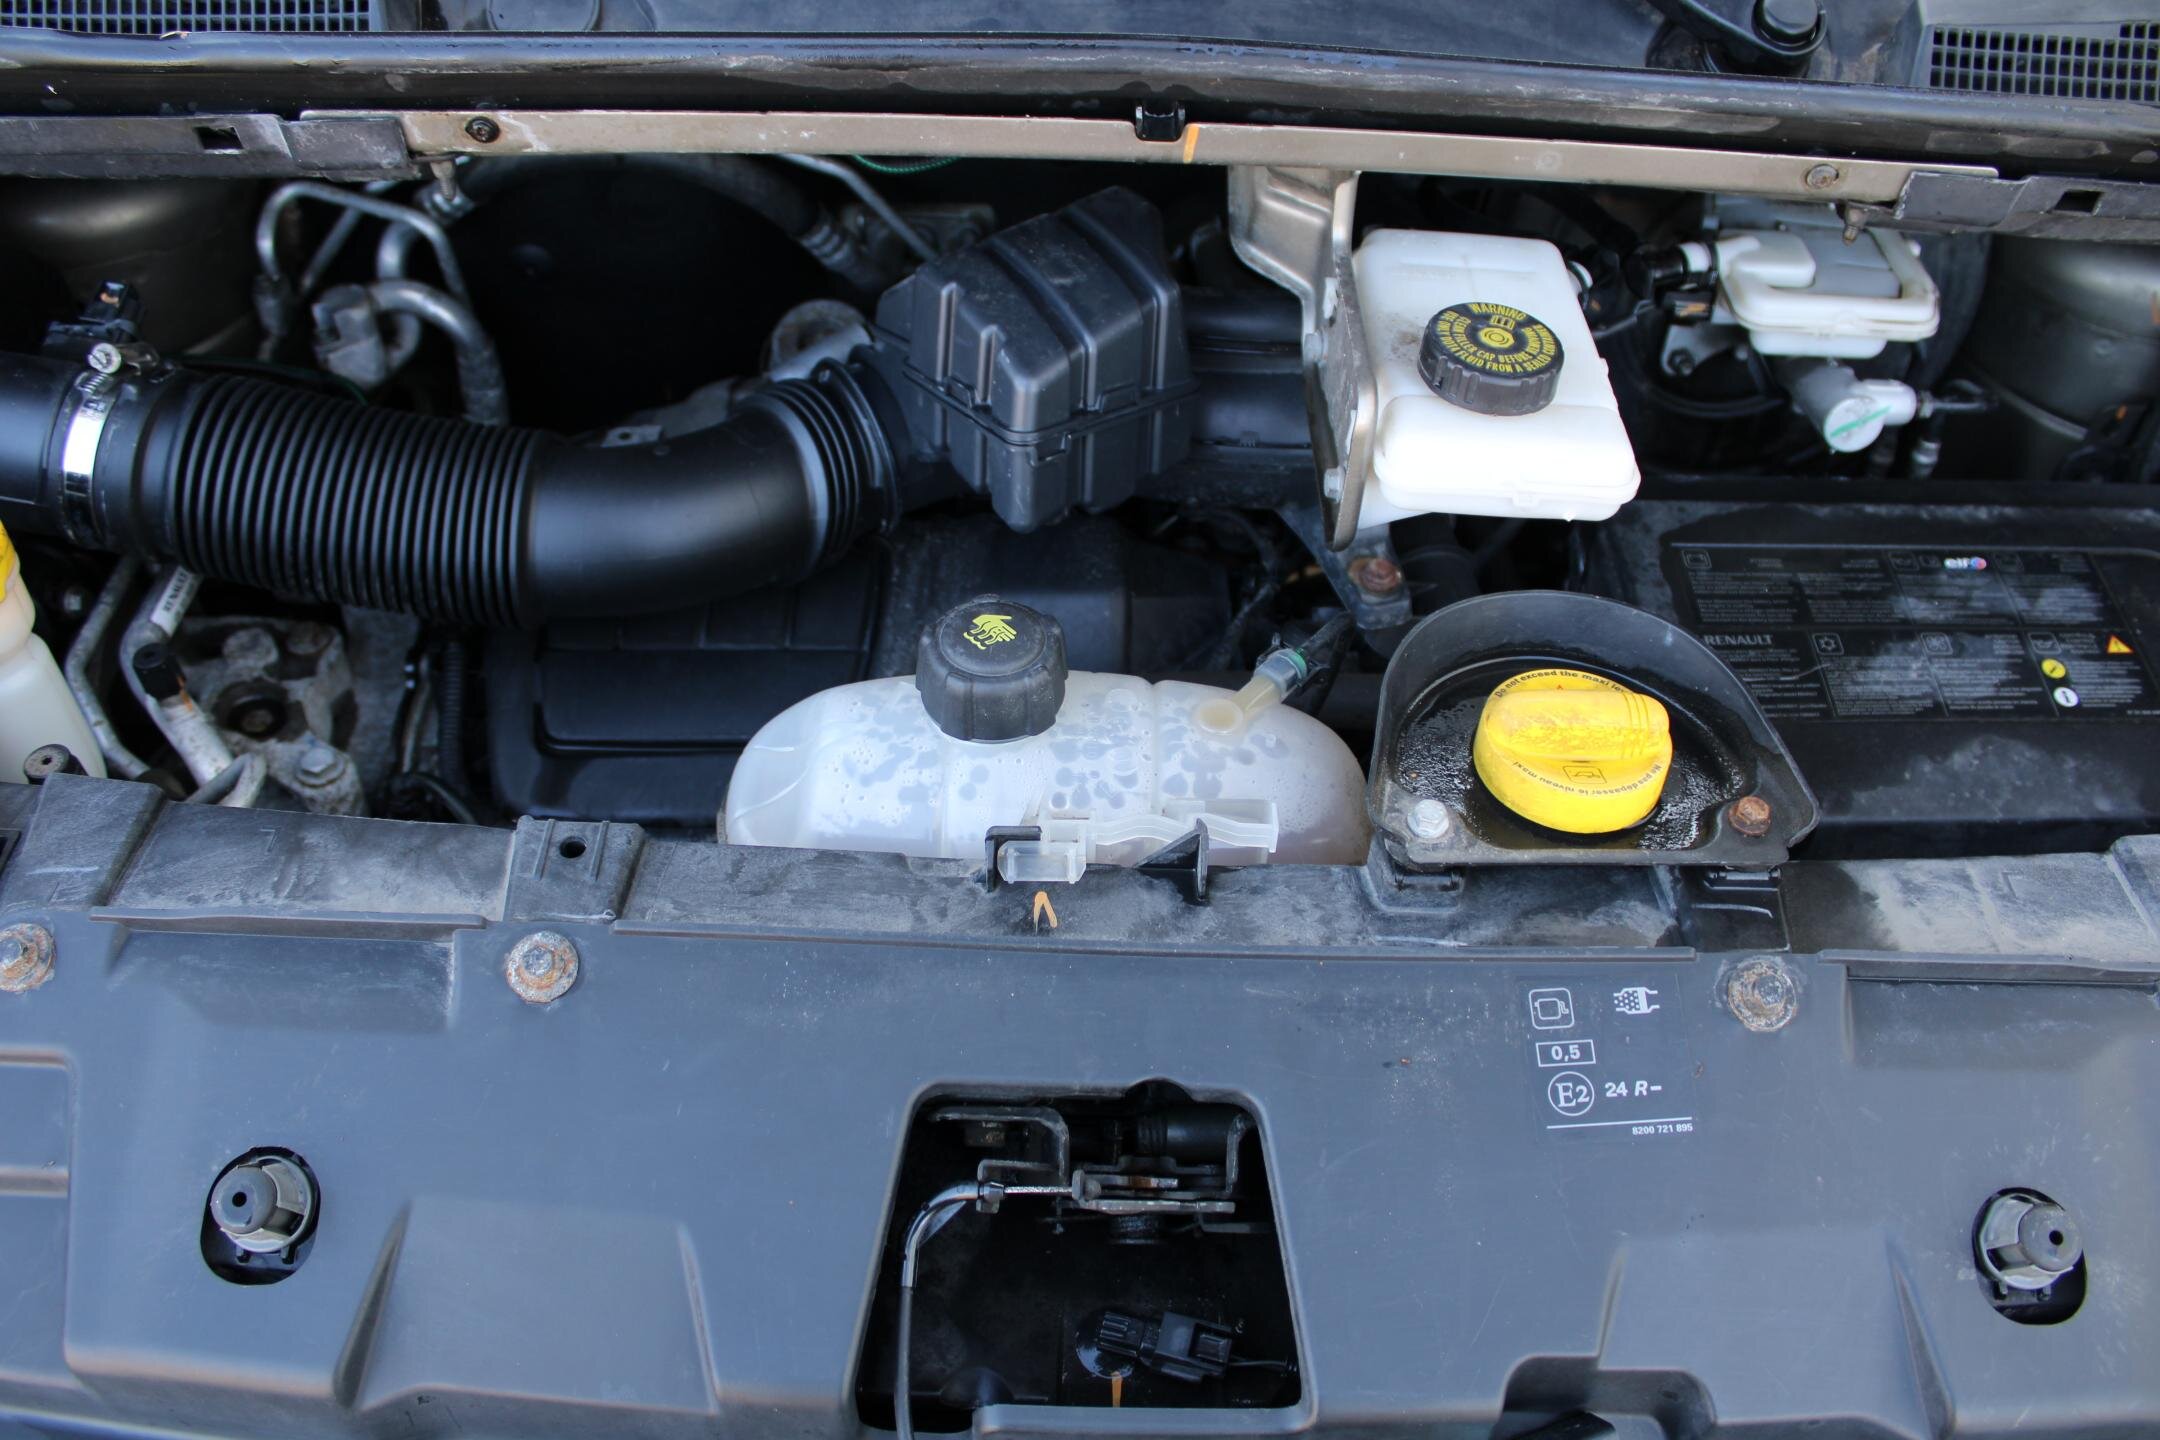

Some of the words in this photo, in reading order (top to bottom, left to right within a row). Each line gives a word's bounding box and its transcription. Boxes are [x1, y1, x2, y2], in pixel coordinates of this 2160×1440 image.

[1468, 303, 1527, 320] WARNING
[1455, 350, 1485, 367] FLUID
[1486, 361, 1513, 373] FROM
[1515, 363, 1524, 373] A
[1476, 350, 1496, 361] CAP
[1703, 633, 1773, 646] RENAULT
[1494, 688, 1506, 698] Do
[1505, 678, 1520, 689] not
[1519, 670, 1557, 681] exceed
[1559, 670, 1578, 678] the
[1582, 674, 1609, 686] maxi
[1512, 761, 1537, 778] maxi
[1539, 776, 1575, 792] niveau
[1637, 773, 1653, 785] pas
[1578, 788, 1589, 796] le
[1551, 1044, 1581, 1062] 0,5
[1555, 1081, 1590, 1107] E2
[1605, 1081, 1628, 1097] 24
[1632, 1126, 1655, 1136] 8200
[1657, 1124, 1674, 1134] 721
[1676, 1122, 1694, 1133] 895
